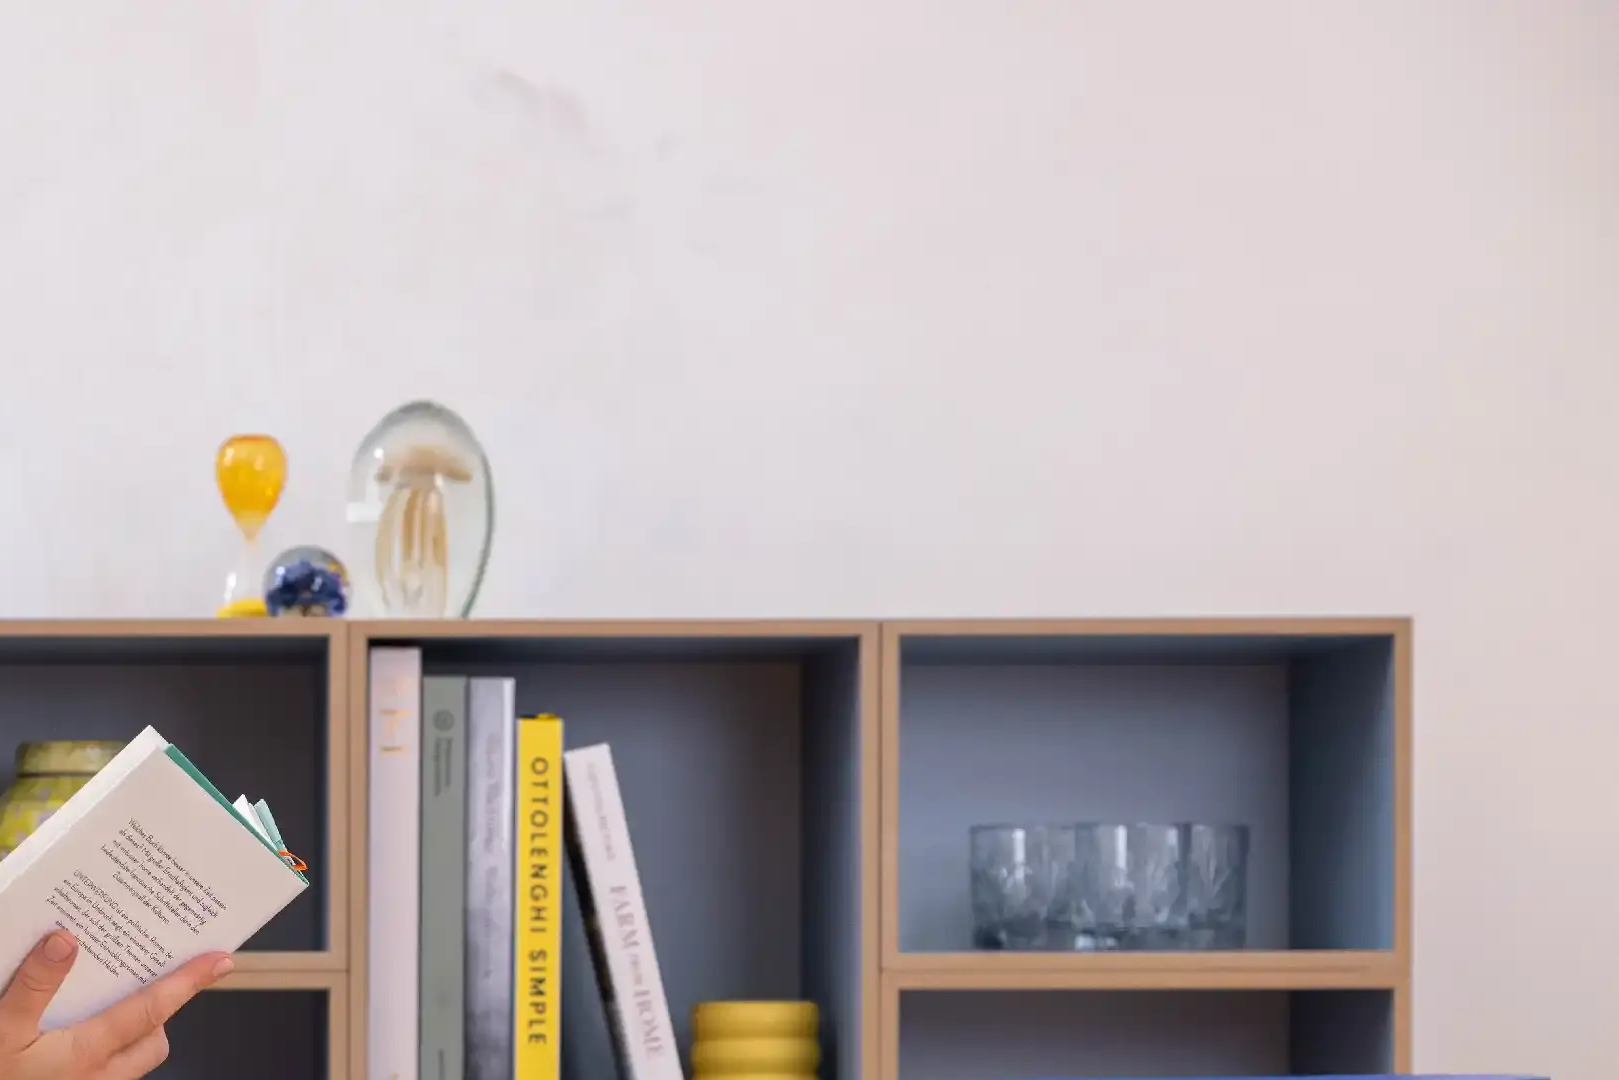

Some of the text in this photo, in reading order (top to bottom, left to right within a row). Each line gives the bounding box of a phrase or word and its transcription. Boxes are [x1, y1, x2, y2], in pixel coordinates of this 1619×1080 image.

[527, 756, 549, 1046] OTTOLENGHI SIMPLE
[608, 884, 641, 951] FARM
[632, 989, 666, 1061] HOME
